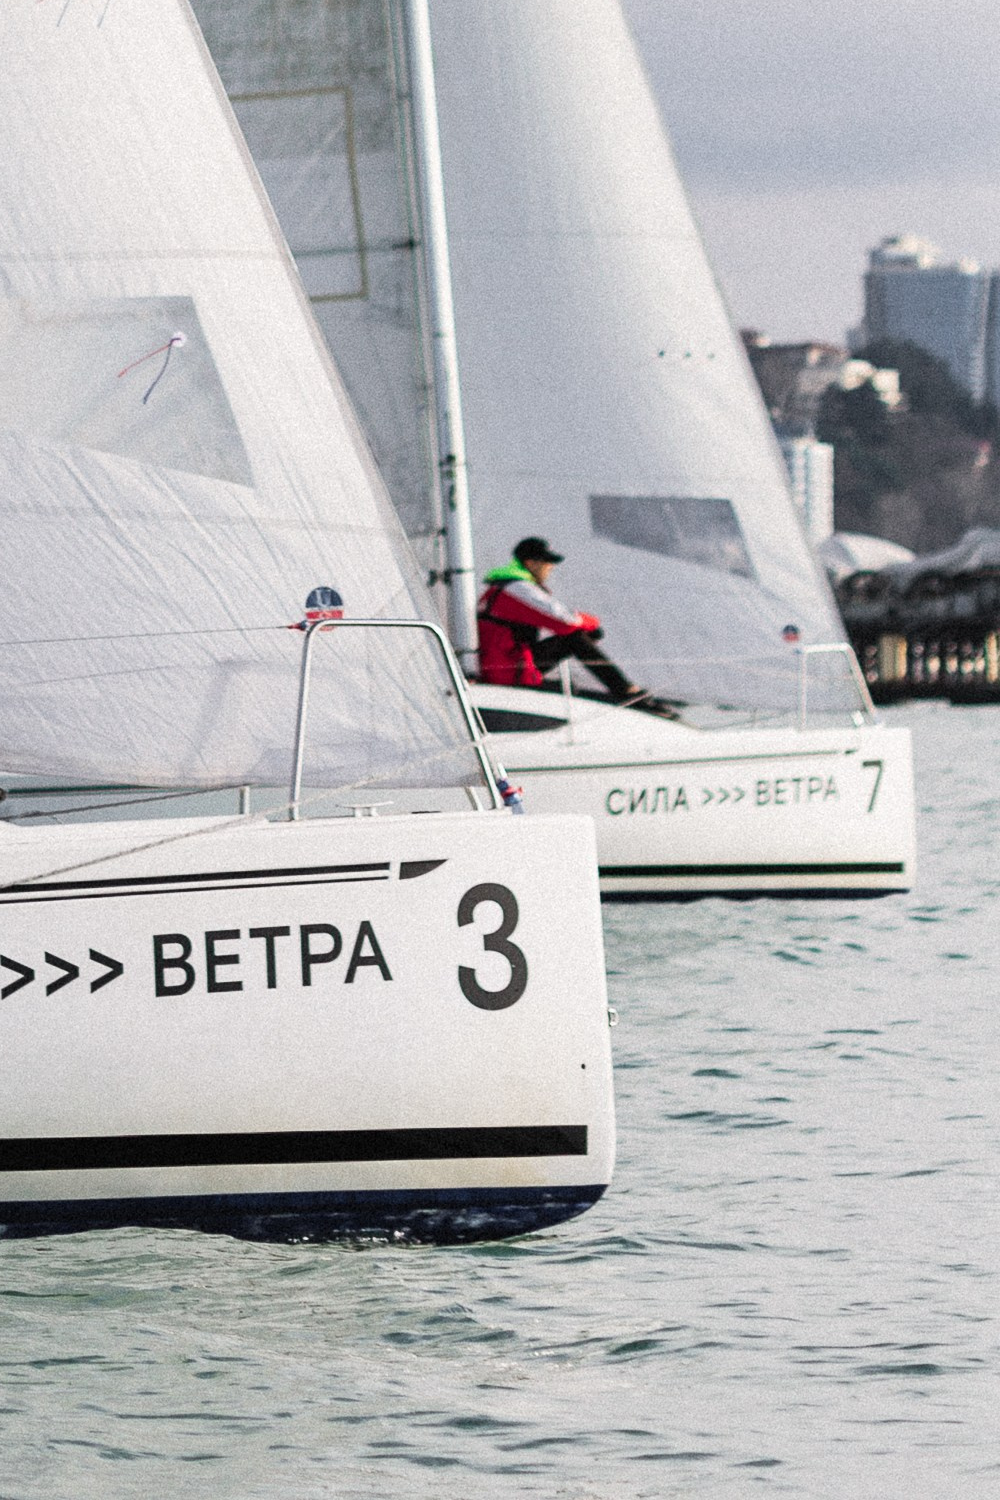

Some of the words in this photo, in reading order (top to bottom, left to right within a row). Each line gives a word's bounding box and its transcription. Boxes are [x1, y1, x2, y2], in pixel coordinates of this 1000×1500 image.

[605, 787, 690, 815] СИЛА
[755, 776, 840, 806] ВЕТРА
[862, 760, 884, 812] 7
[153, 920, 393, 998] ВЕТРА
[457, 883, 528, 1011] 3
